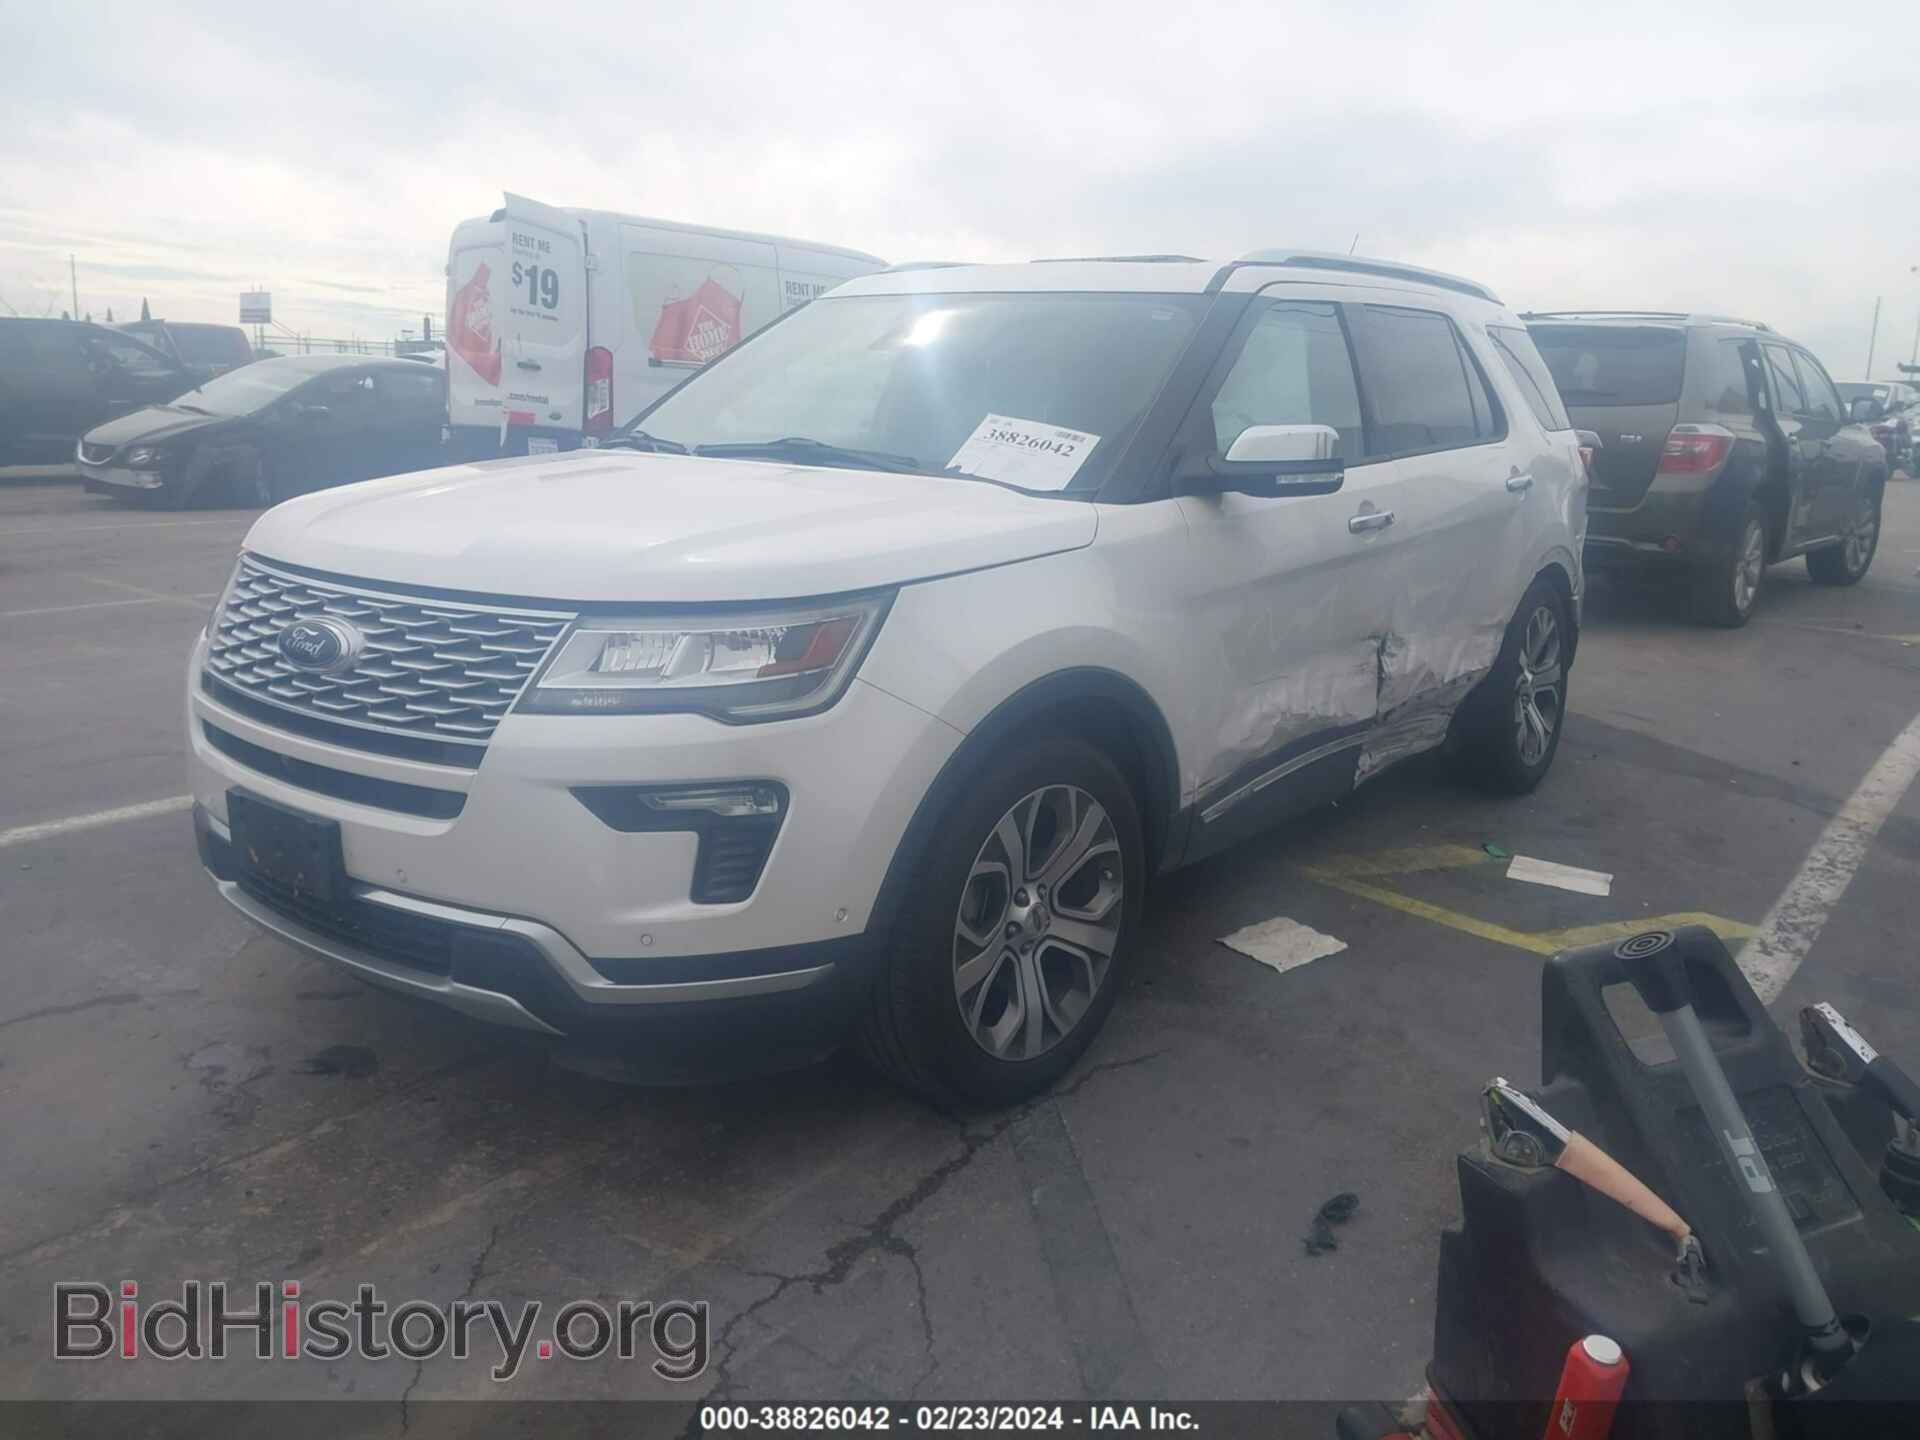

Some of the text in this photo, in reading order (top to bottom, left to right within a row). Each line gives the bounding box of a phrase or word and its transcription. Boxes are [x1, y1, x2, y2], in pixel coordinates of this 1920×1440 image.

[511, 232, 535, 249] RENT
[511, 261, 560, 310] $19
[785, 280, 809, 297] RENT
[984, 428, 1075, 457] 38826042
